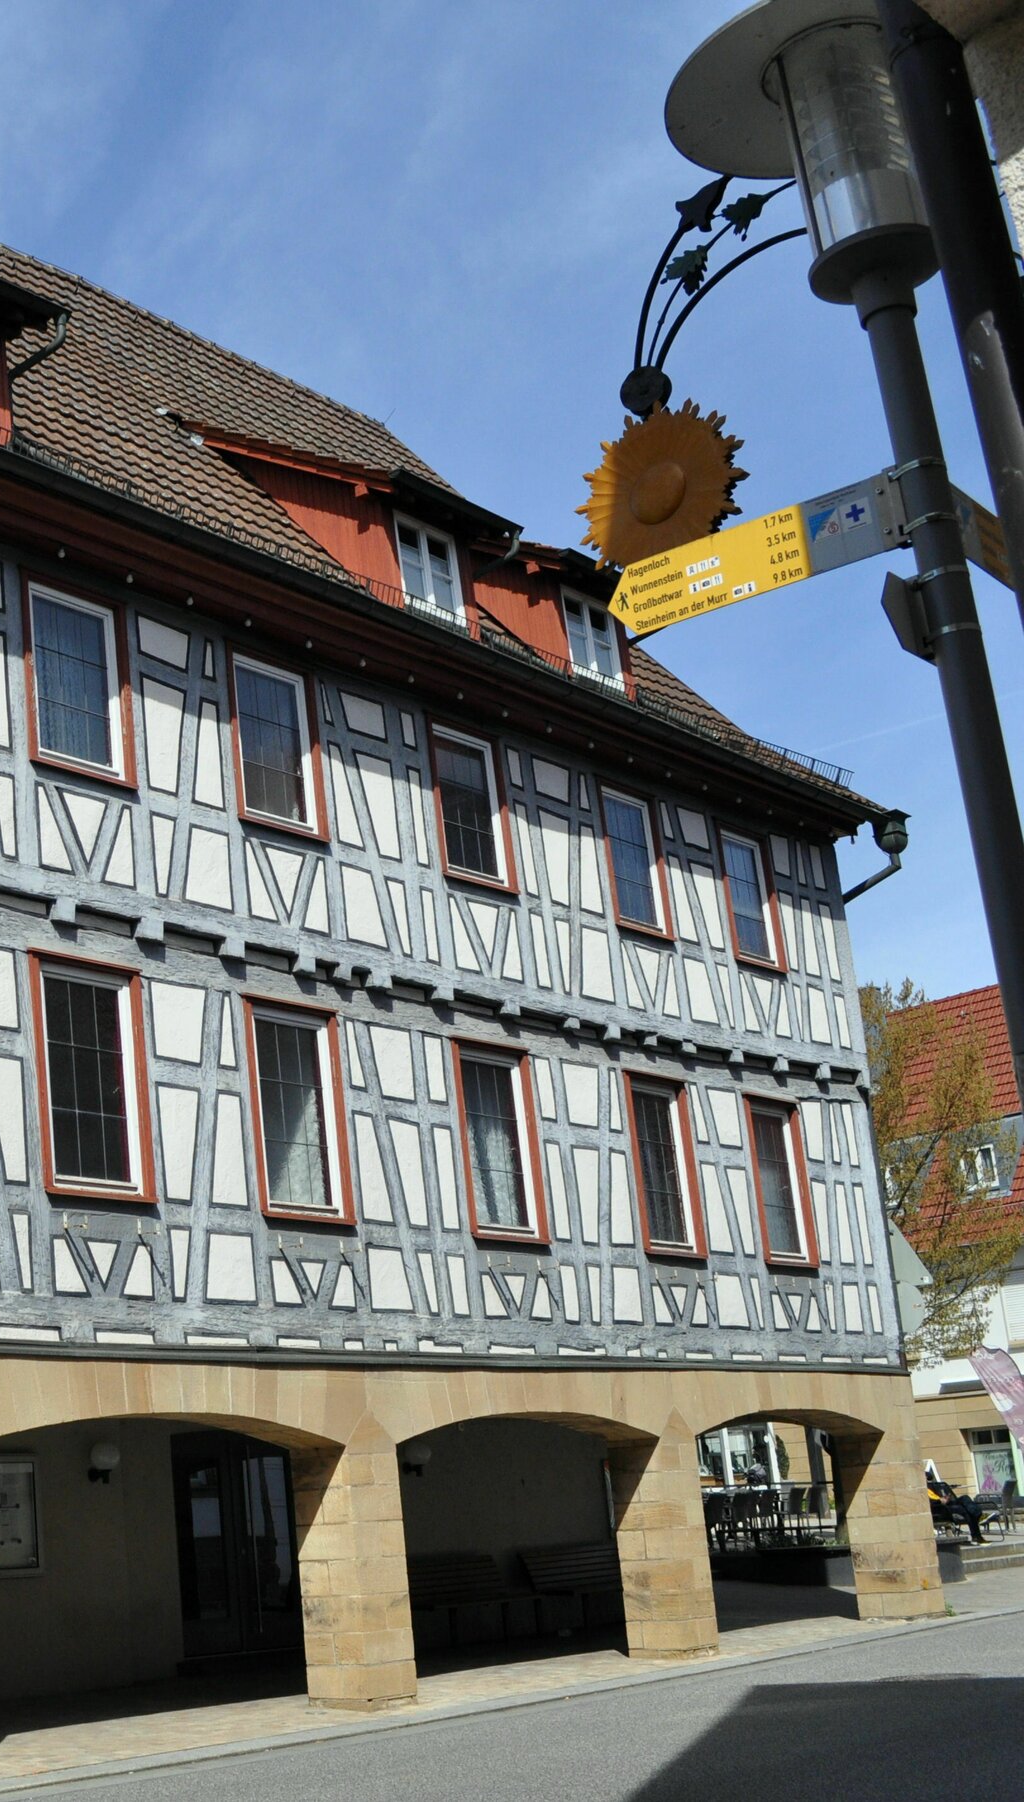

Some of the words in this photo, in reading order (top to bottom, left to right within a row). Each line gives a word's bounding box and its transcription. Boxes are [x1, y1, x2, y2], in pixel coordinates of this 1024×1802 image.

[627, 555, 671, 579] Hagenloch
[763, 516, 776, 529] 1.7
[778, 512, 793, 524] km
[630, 570, 683, 596] Wunnenstein
[766, 534, 780, 547] 3.5
[781, 530, 797, 542] km
[633, 589, 684, 613] Großbottwar
[769, 552, 784, 565] 4.8
[784, 548, 800, 561] km
[635, 610, 677, 631] Steinheim
[678, 606, 690, 616] an
[691, 599, 706, 612] der
[707, 592, 728, 606] Murr
[772, 570, 787, 584] 9.8
[788, 567, 803, 579] km
